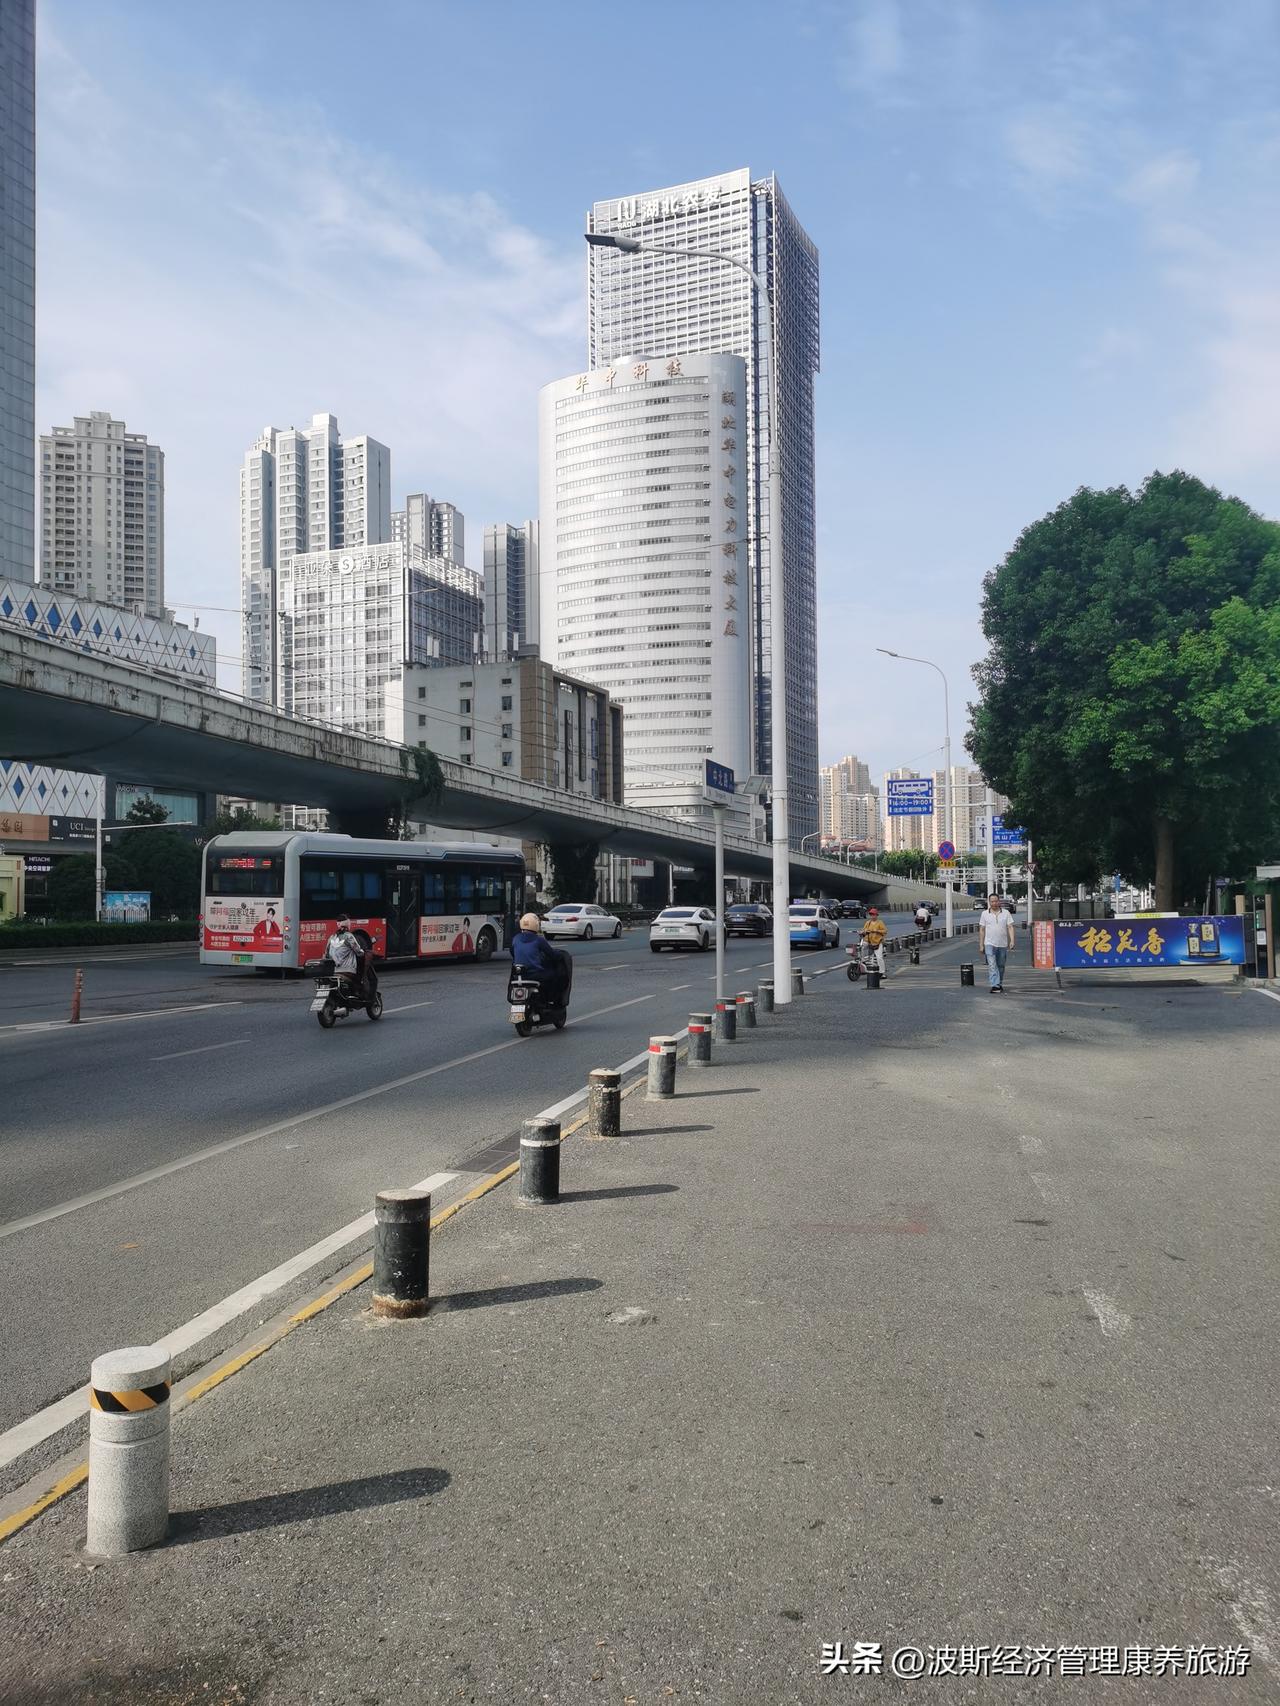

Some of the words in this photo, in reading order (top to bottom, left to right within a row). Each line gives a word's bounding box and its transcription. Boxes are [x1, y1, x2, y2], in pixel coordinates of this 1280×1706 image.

[576, 358, 684, 393] 华中科技
[1077, 926, 1165, 957] 稻花香
